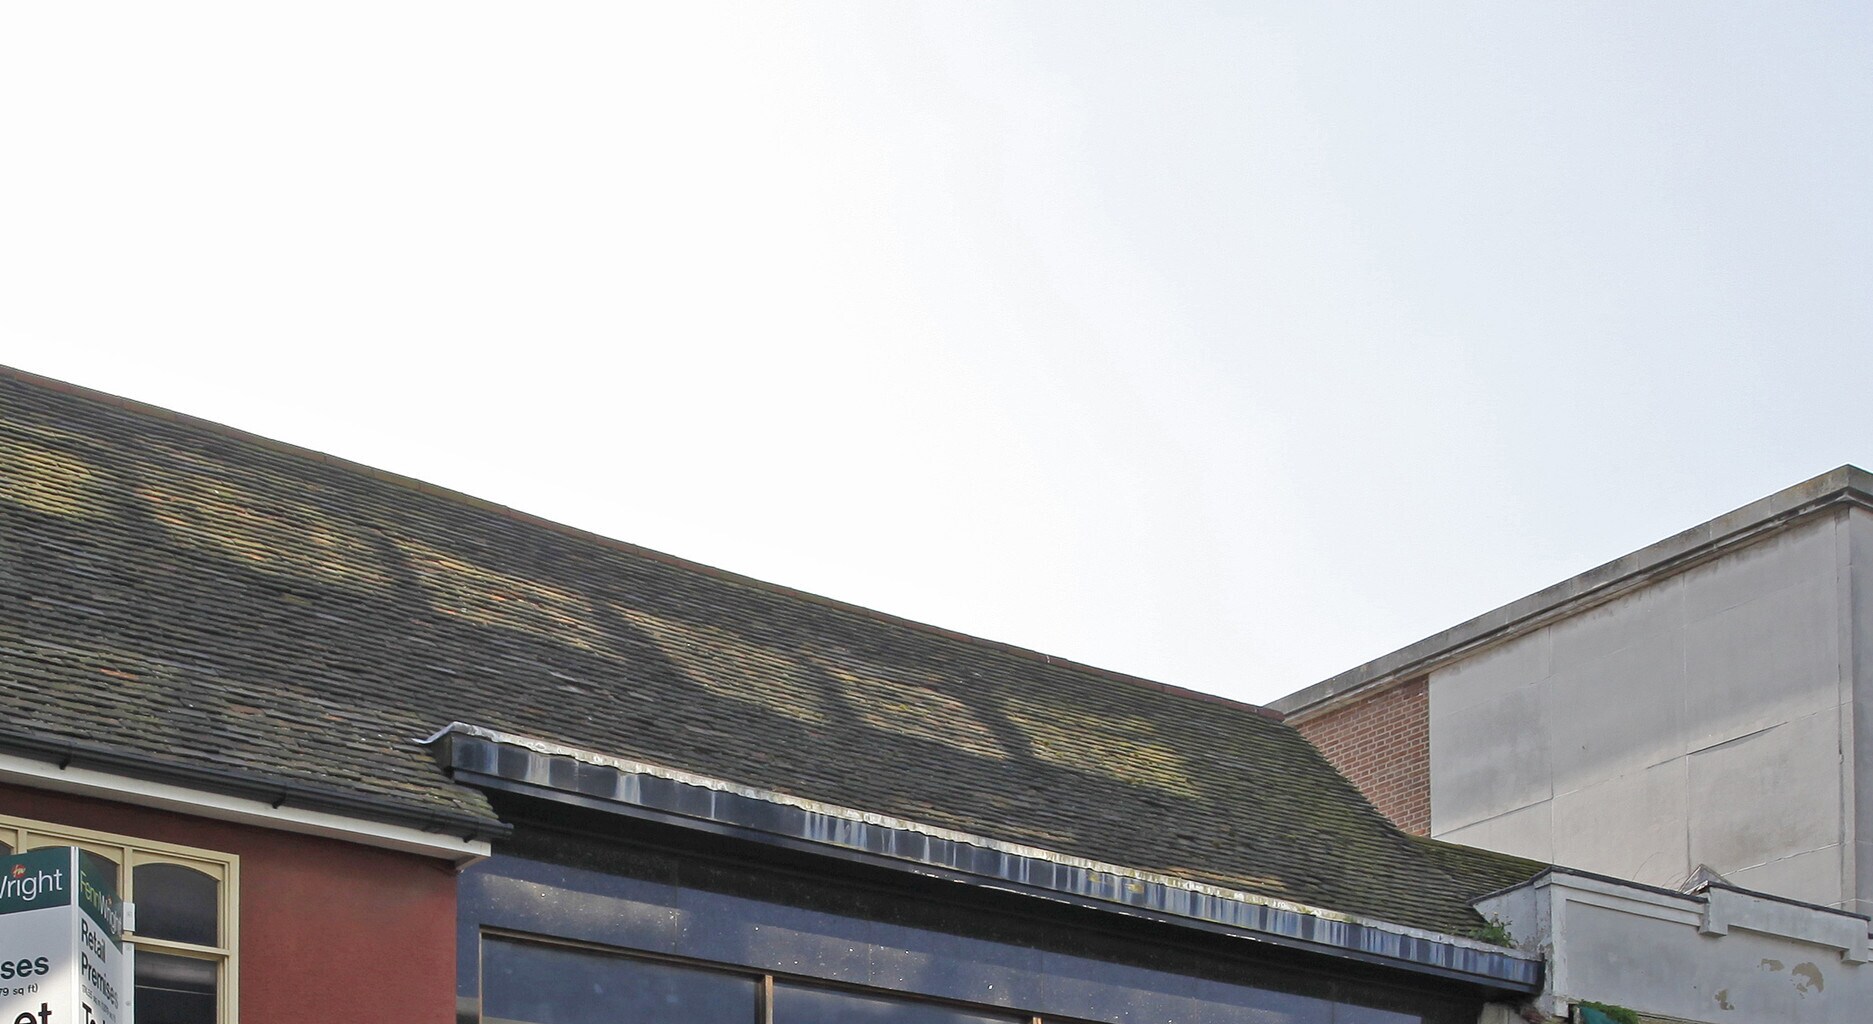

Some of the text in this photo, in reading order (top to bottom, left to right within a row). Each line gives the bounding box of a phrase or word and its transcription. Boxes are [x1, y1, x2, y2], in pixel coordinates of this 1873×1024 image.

[81, 918, 106, 962] Retail
[13, 987, 24, 996] sq
[81, 951, 119, 1009] Premises
